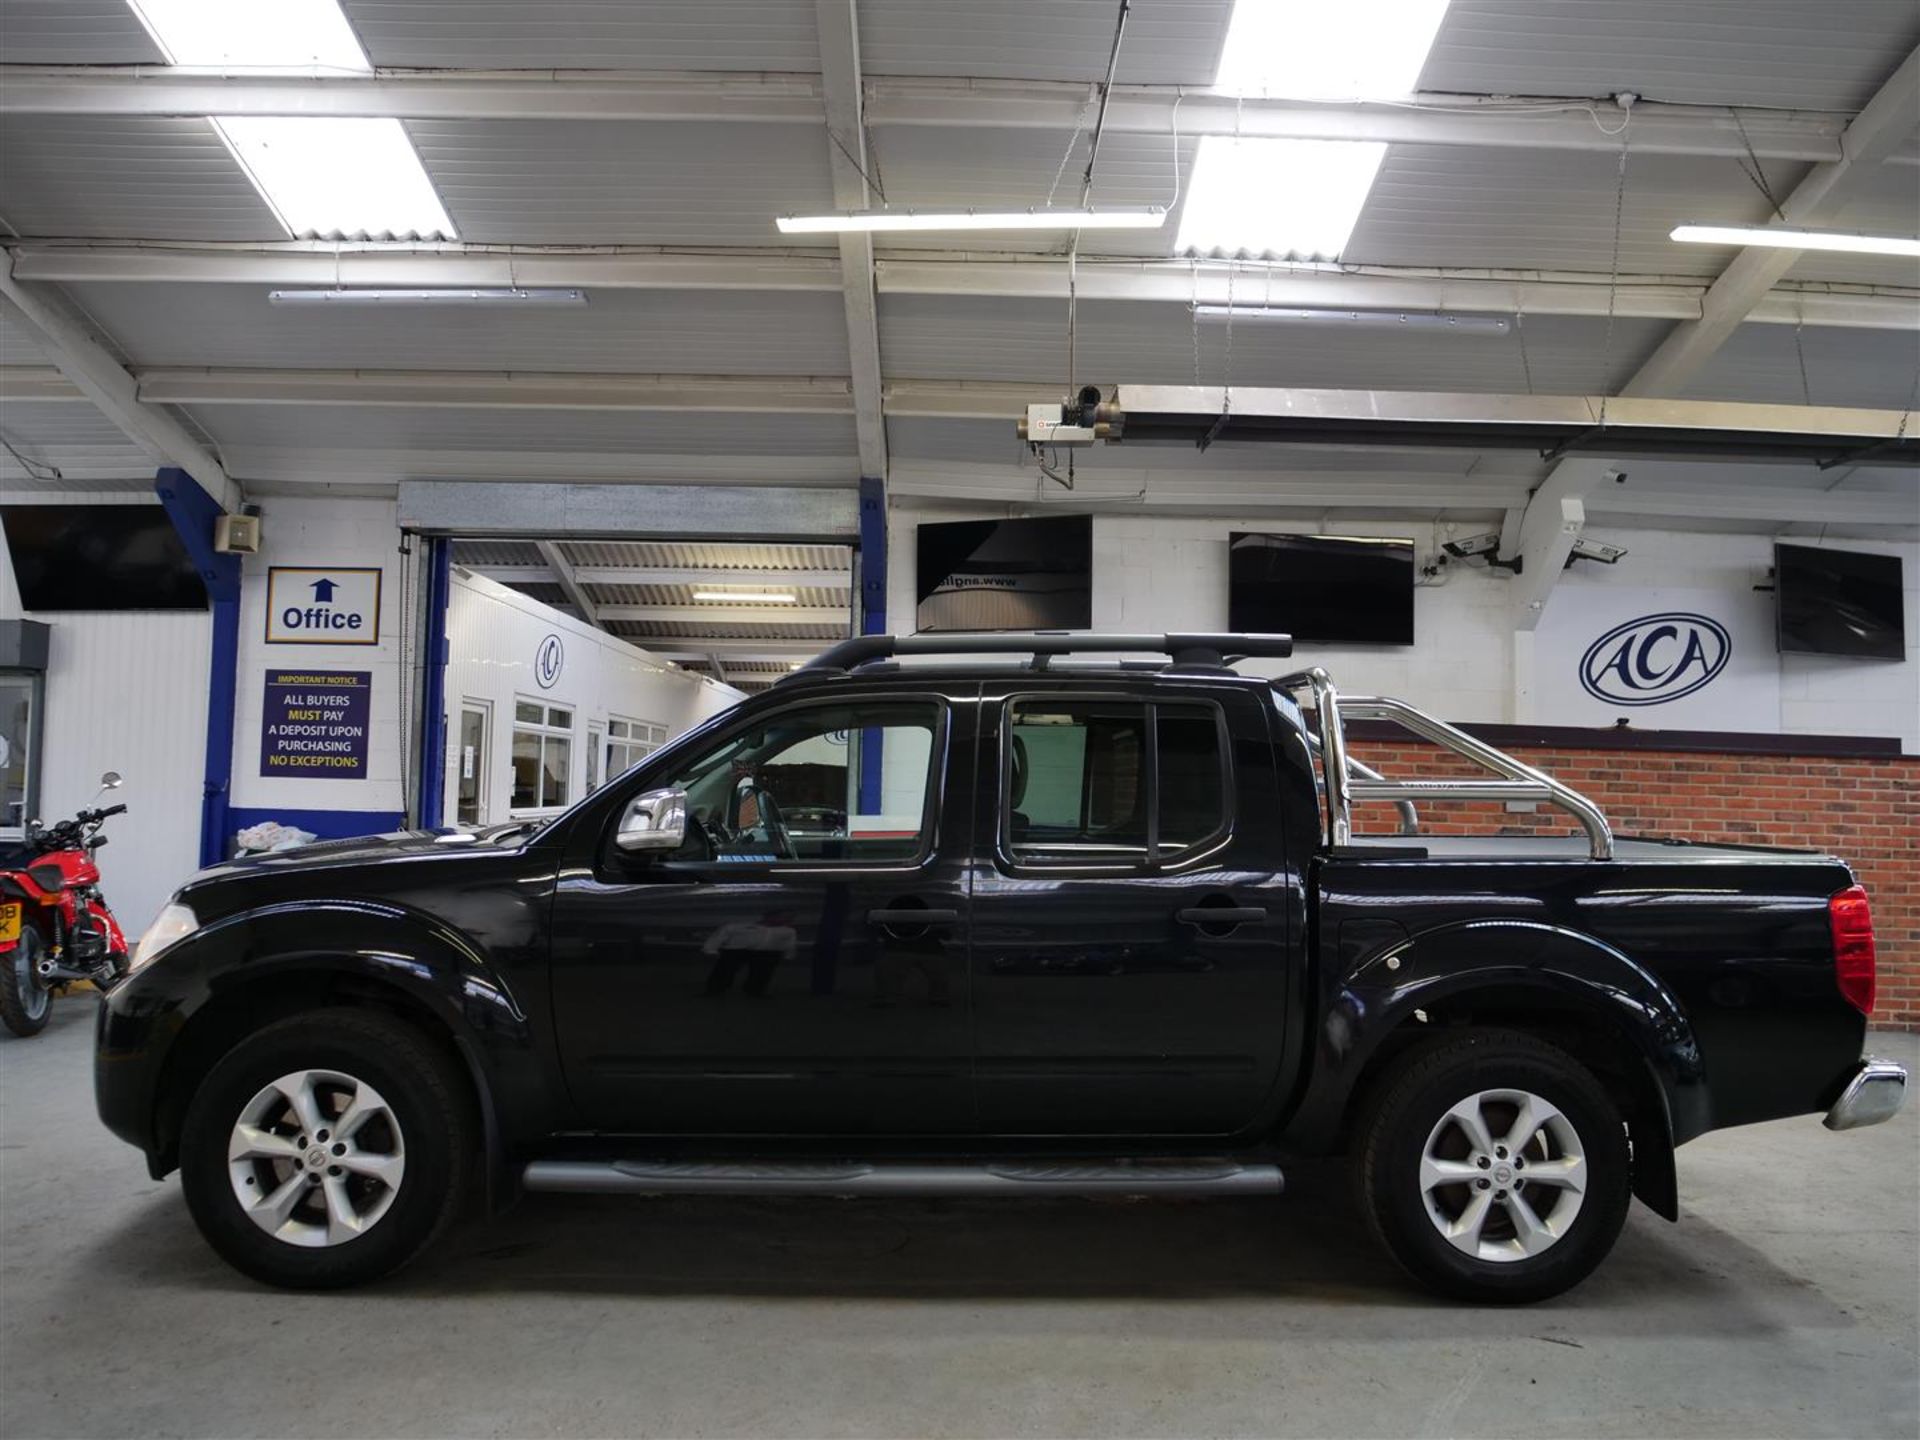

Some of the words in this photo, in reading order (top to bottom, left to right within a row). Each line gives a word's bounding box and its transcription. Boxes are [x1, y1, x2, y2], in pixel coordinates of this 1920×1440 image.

[283, 607, 362, 629] Office
[1592, 625, 1711, 691] ACA
[278, 675, 325, 684] IMPORTANT
[327, 676, 358, 685] NOTICE
[284, 694, 304, 705] ALL
[307, 695, 350, 706] BUYERS
[288, 710, 321, 720] MUST
[323, 711, 344, 721] PAY
[268, 725, 277, 735] A
[279, 725, 327, 736] DEPOSIT
[329, 726, 362, 737] UPON
[278, 740, 351, 752] PURCHASING
[269, 755, 287, 766] NO
[290, 756, 358, 767] EXCEPTIONS
